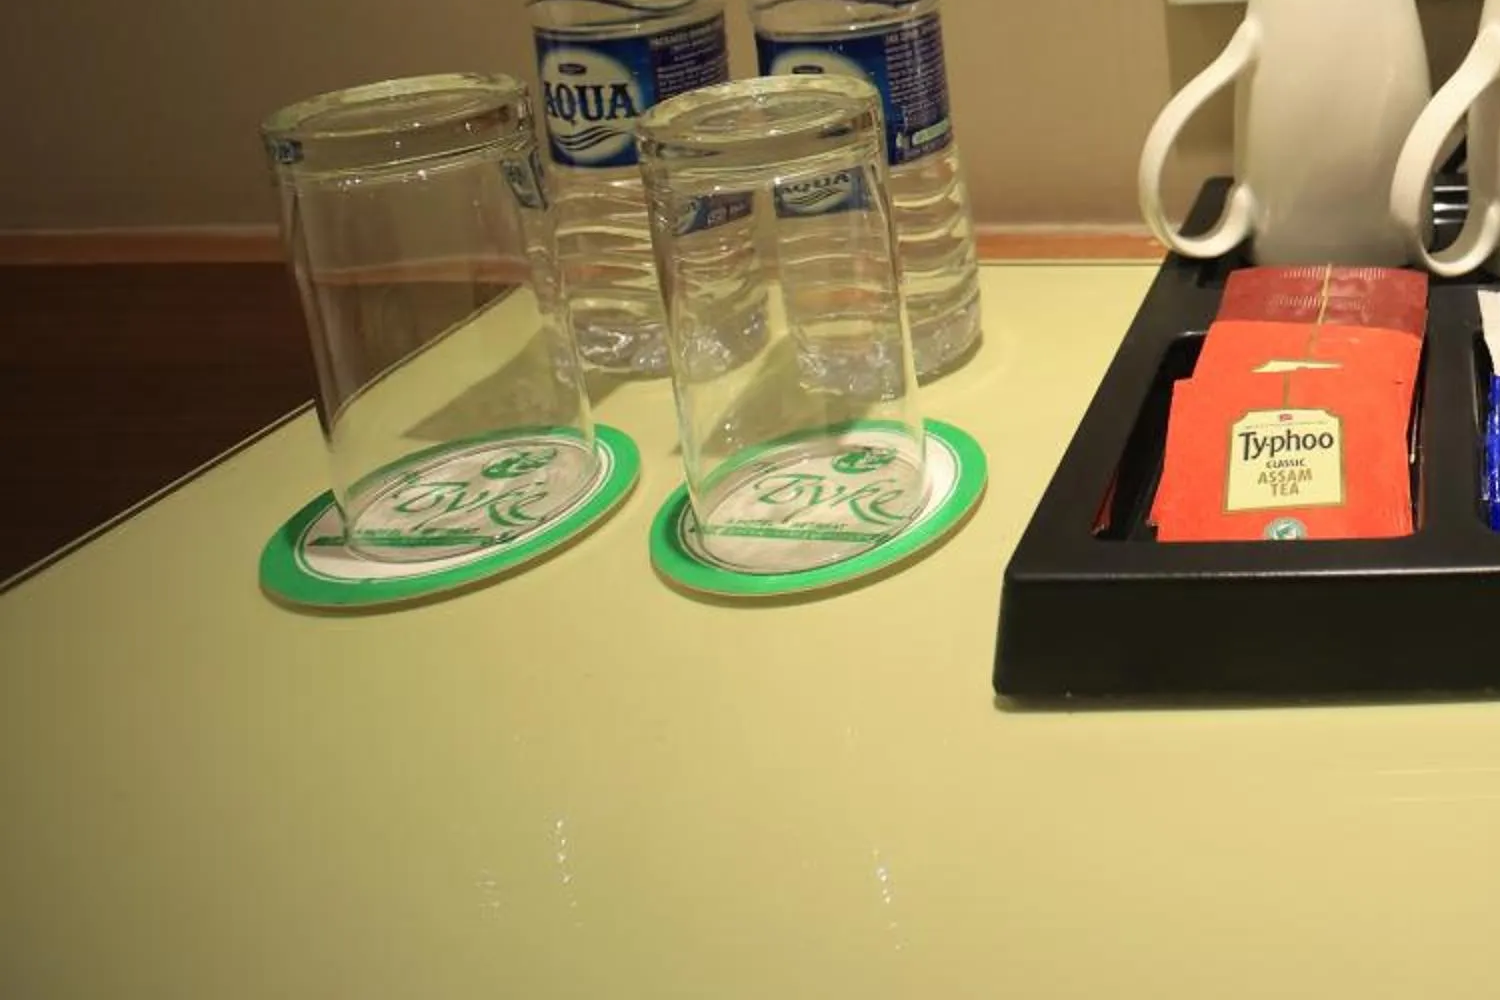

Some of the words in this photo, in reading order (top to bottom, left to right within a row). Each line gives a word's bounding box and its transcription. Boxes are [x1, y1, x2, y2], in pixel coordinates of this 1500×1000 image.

[1265, 458, 1305, 469] CLASSIC
[1257, 468, 1313, 485] ASSAM
[1270, 482, 1300, 497] TEA
